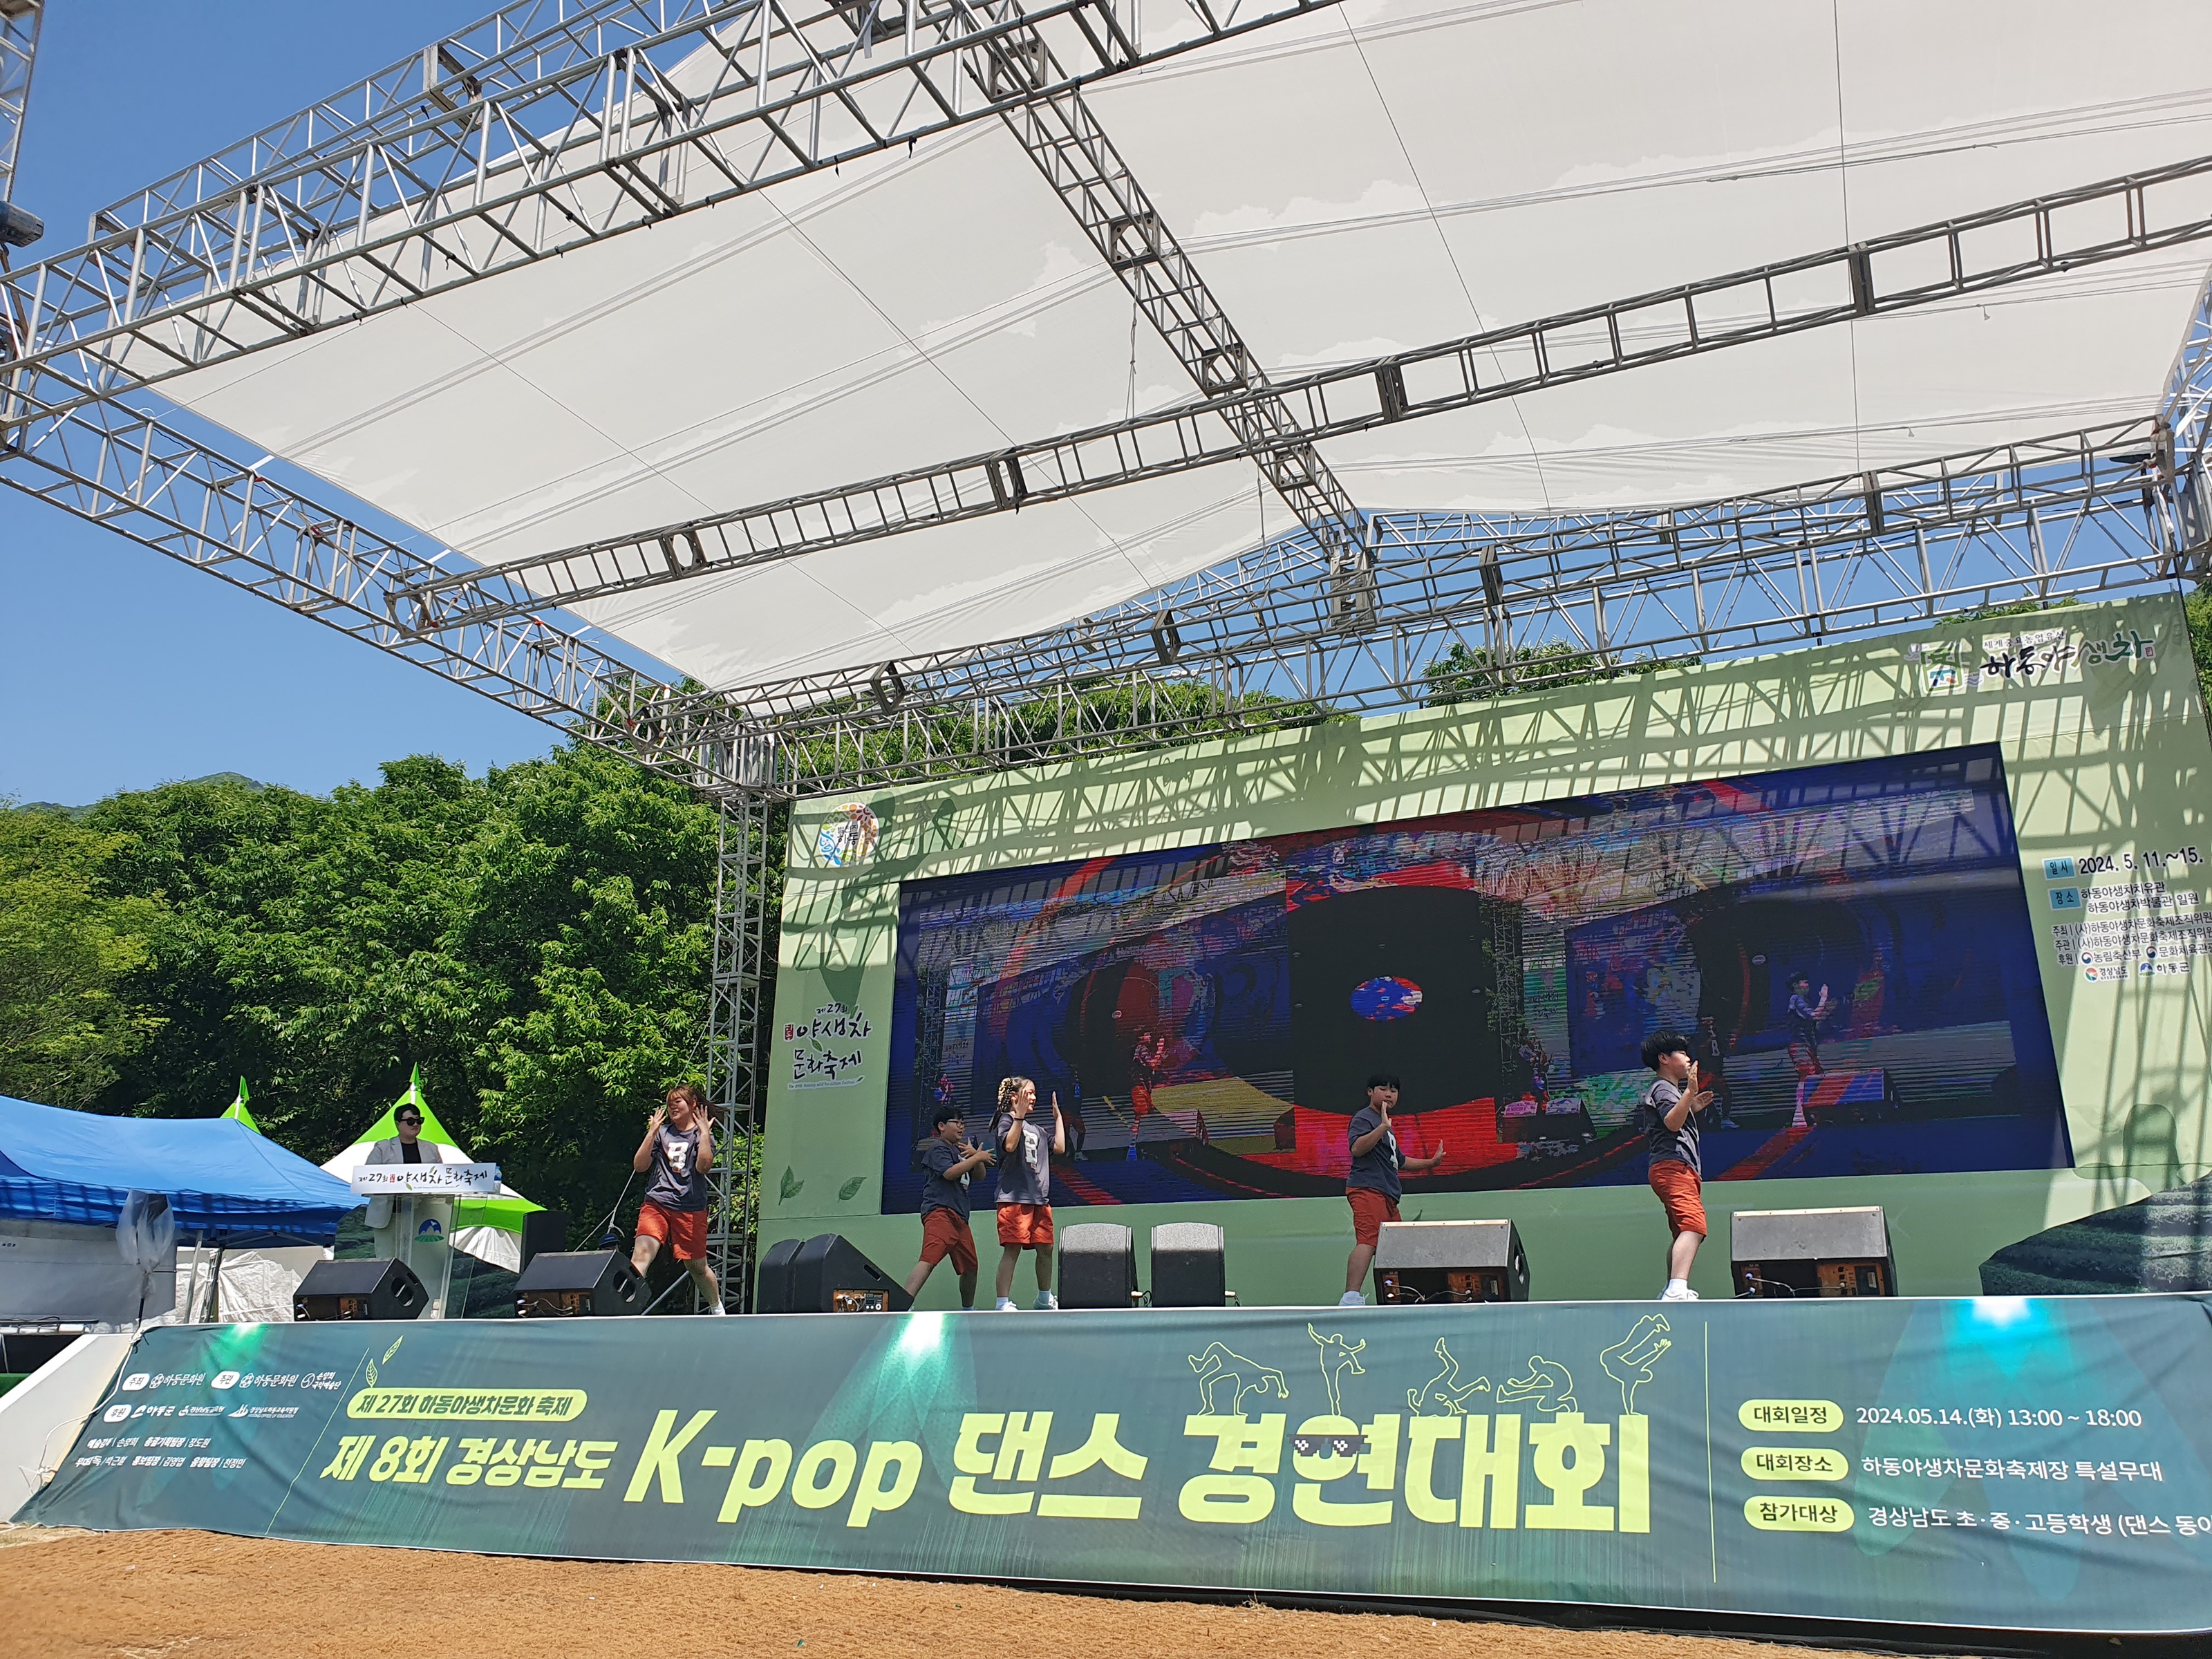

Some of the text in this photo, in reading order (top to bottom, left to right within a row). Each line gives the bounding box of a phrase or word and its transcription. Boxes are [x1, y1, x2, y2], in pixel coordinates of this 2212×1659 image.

[2079, 855, 2119, 874] 2024.
[2124, 853, 2138, 870] 5.
[2081, 881, 2166, 899] 하동야생차치유관
[2088, 892, 2200, 913] 하동야생차박물관 일원
[2053, 925, 2068, 937] 주최
[2055, 939, 2071, 951] 주관
[2059, 953, 2074, 965] 후원
[2093, 949, 2141, 963] 농림축산부
[2099, 962, 2190, 976] 경상남도 하동군
[816, 1003, 847, 1014] 제27회
[796, 1012, 872, 1038] 야생차
[794, 1049, 861, 1080] 문화축제
[163, 1372, 206, 1387] 하동문화원
[254, 1374, 299, 1387] 하동문화원
[355, 1394, 574, 1416] 제 27회 하동야생차문화 축제
[1754, 1406, 1828, 1424] 대회일정
[2007, 1409, 2063, 1427] 13:00
[2085, 1409, 2141, 1427] 18:00
[321, 1409, 1651, 1533] 제 8회 경상남도 K-pop 댄스 경연대회
[1756, 1454, 2164, 1482] 대회장소 하동야생차문화축제장 특설무대
[1759, 1502, 1838, 1524] 참가대상
[1868, 1506, 1951, 1528] 경상남도
[2118, 1513, 2172, 1538] (댄스
